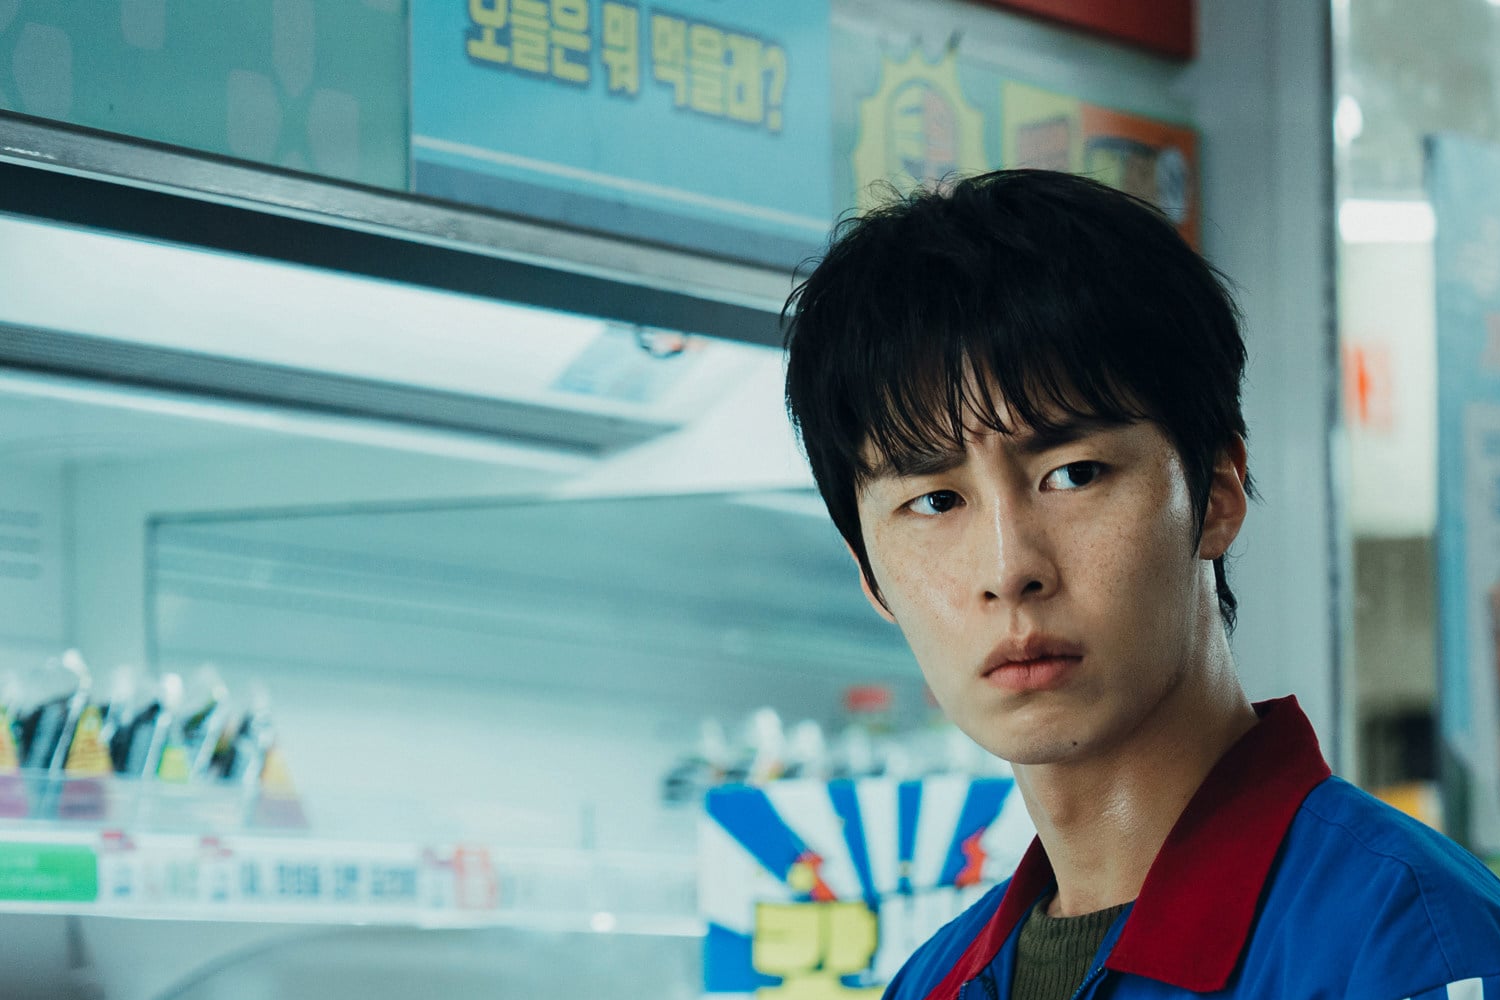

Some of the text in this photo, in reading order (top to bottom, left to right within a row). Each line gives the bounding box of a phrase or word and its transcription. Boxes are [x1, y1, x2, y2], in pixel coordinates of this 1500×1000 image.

[466, 0, 786, 131] 오늘은 뭐 먹을래?
